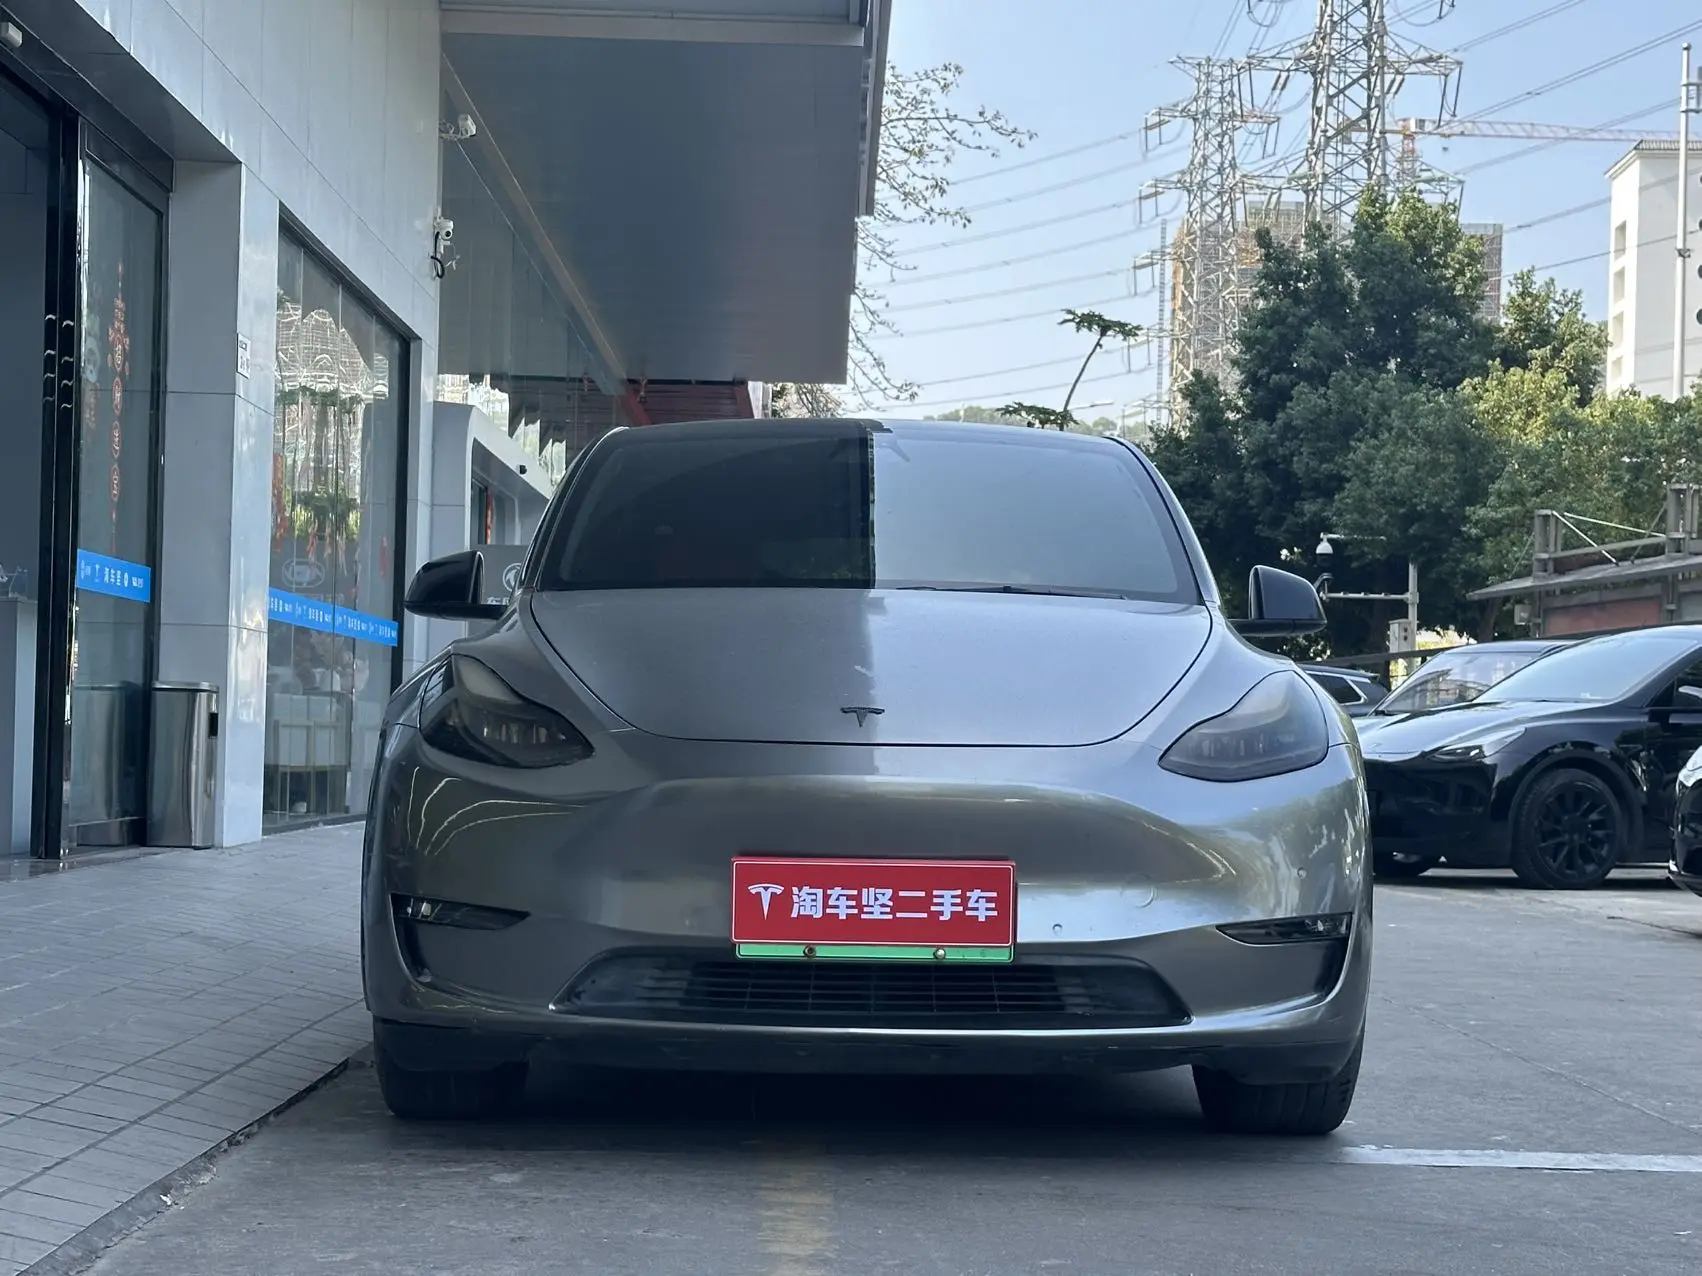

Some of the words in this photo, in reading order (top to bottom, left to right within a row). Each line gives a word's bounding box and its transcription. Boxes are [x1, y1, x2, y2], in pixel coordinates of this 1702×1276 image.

[790, 886, 998, 921] 淘车坚二手车
